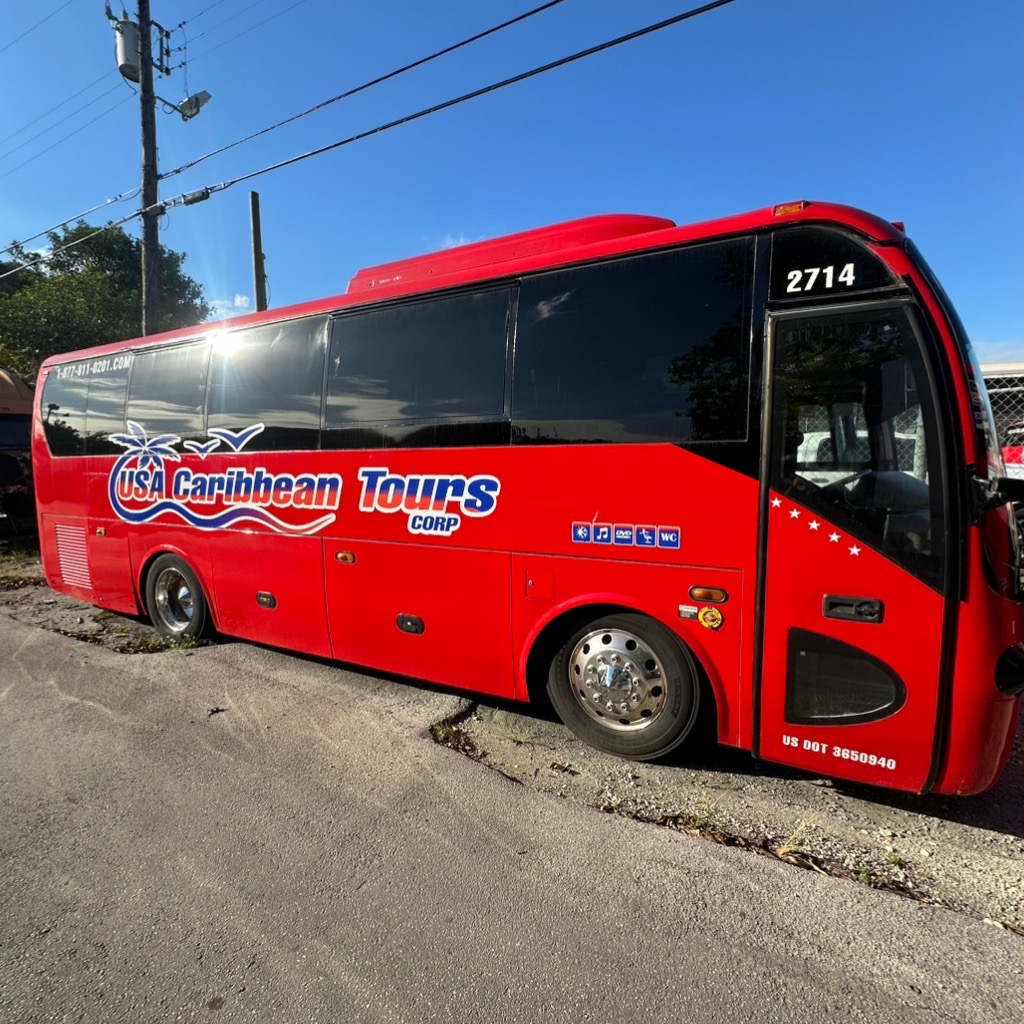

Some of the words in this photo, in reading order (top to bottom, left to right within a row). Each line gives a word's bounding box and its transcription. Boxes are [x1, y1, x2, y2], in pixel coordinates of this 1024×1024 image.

[786, 262, 856, 293] 2714
[118, 467, 166, 501] USA
[172, 467, 342, 509] Caribbean
[358, 467, 500, 514] Tours
[409, 513, 460, 534] CORP
[660, 532, 677, 542] WC
[782, 735, 799, 748] US
[803, 739, 829, 754] DOT
[832, 746, 897, 770] 3650940
